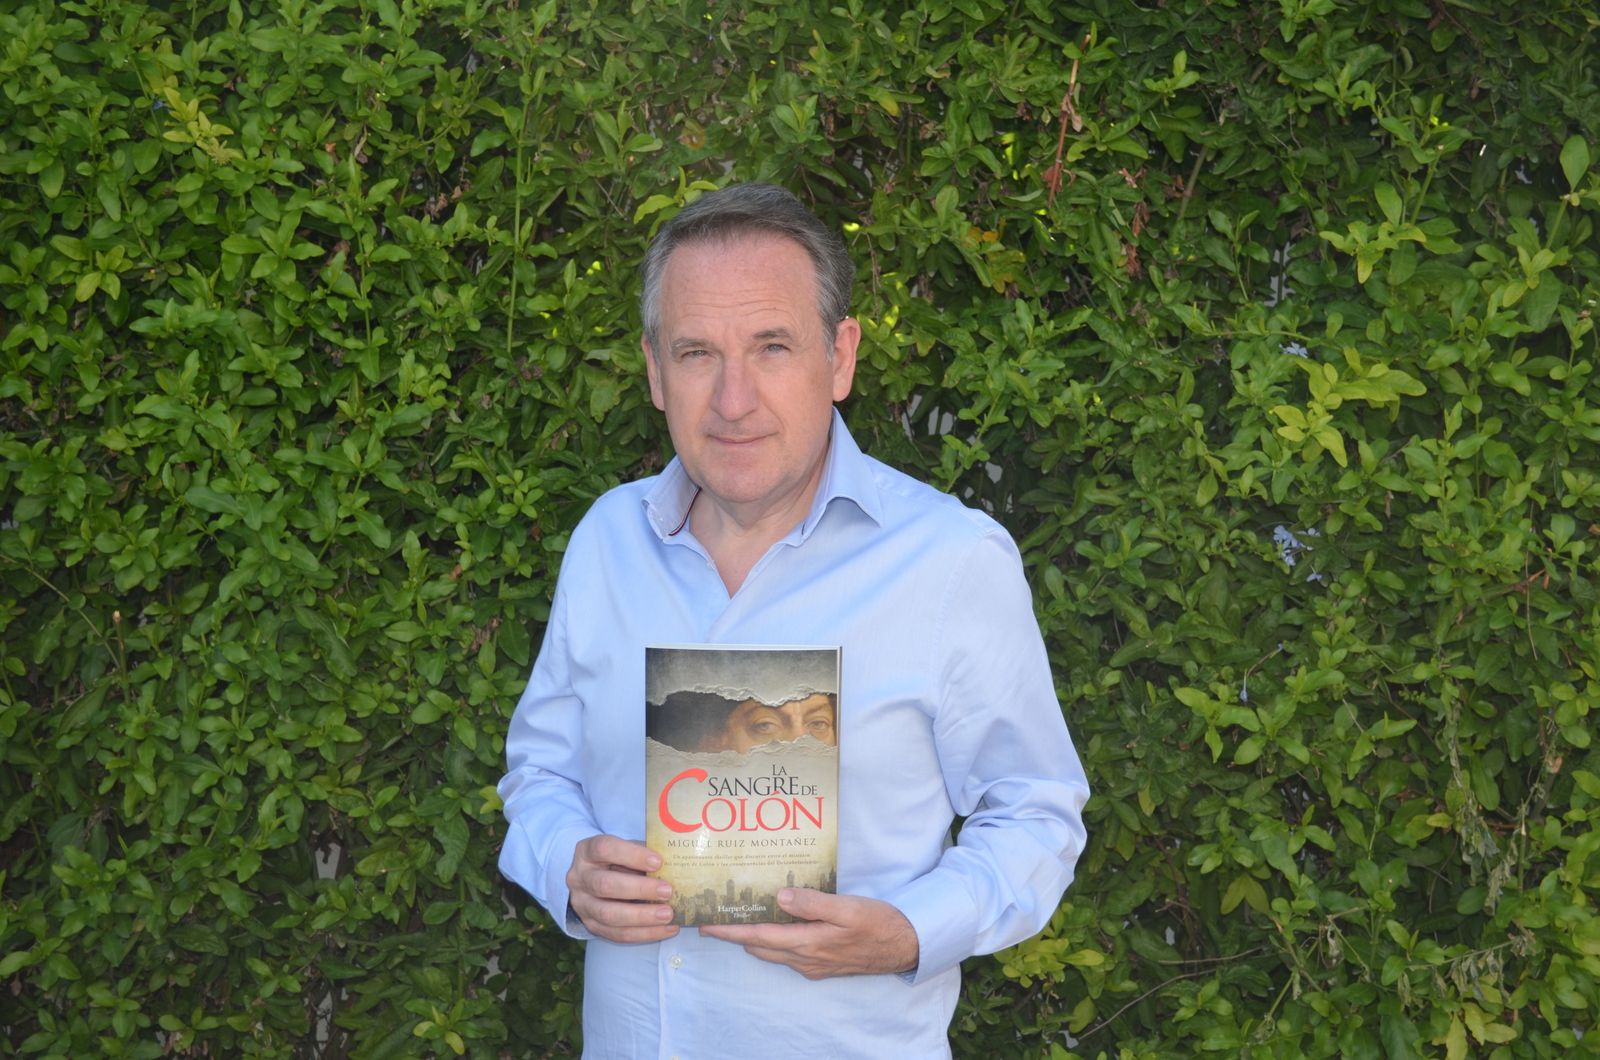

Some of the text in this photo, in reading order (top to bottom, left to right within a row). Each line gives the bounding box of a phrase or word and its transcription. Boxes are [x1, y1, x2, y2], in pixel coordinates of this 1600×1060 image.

[772, 764, 787, 776] LA
[708, 776, 818, 796] SANGRE DE
[658, 767, 825, 833] COLÓN
[667, 836, 817, 848] MIGUL RUIZ MONTAÑEZ
[717, 904, 767, 914] HarperCollins
